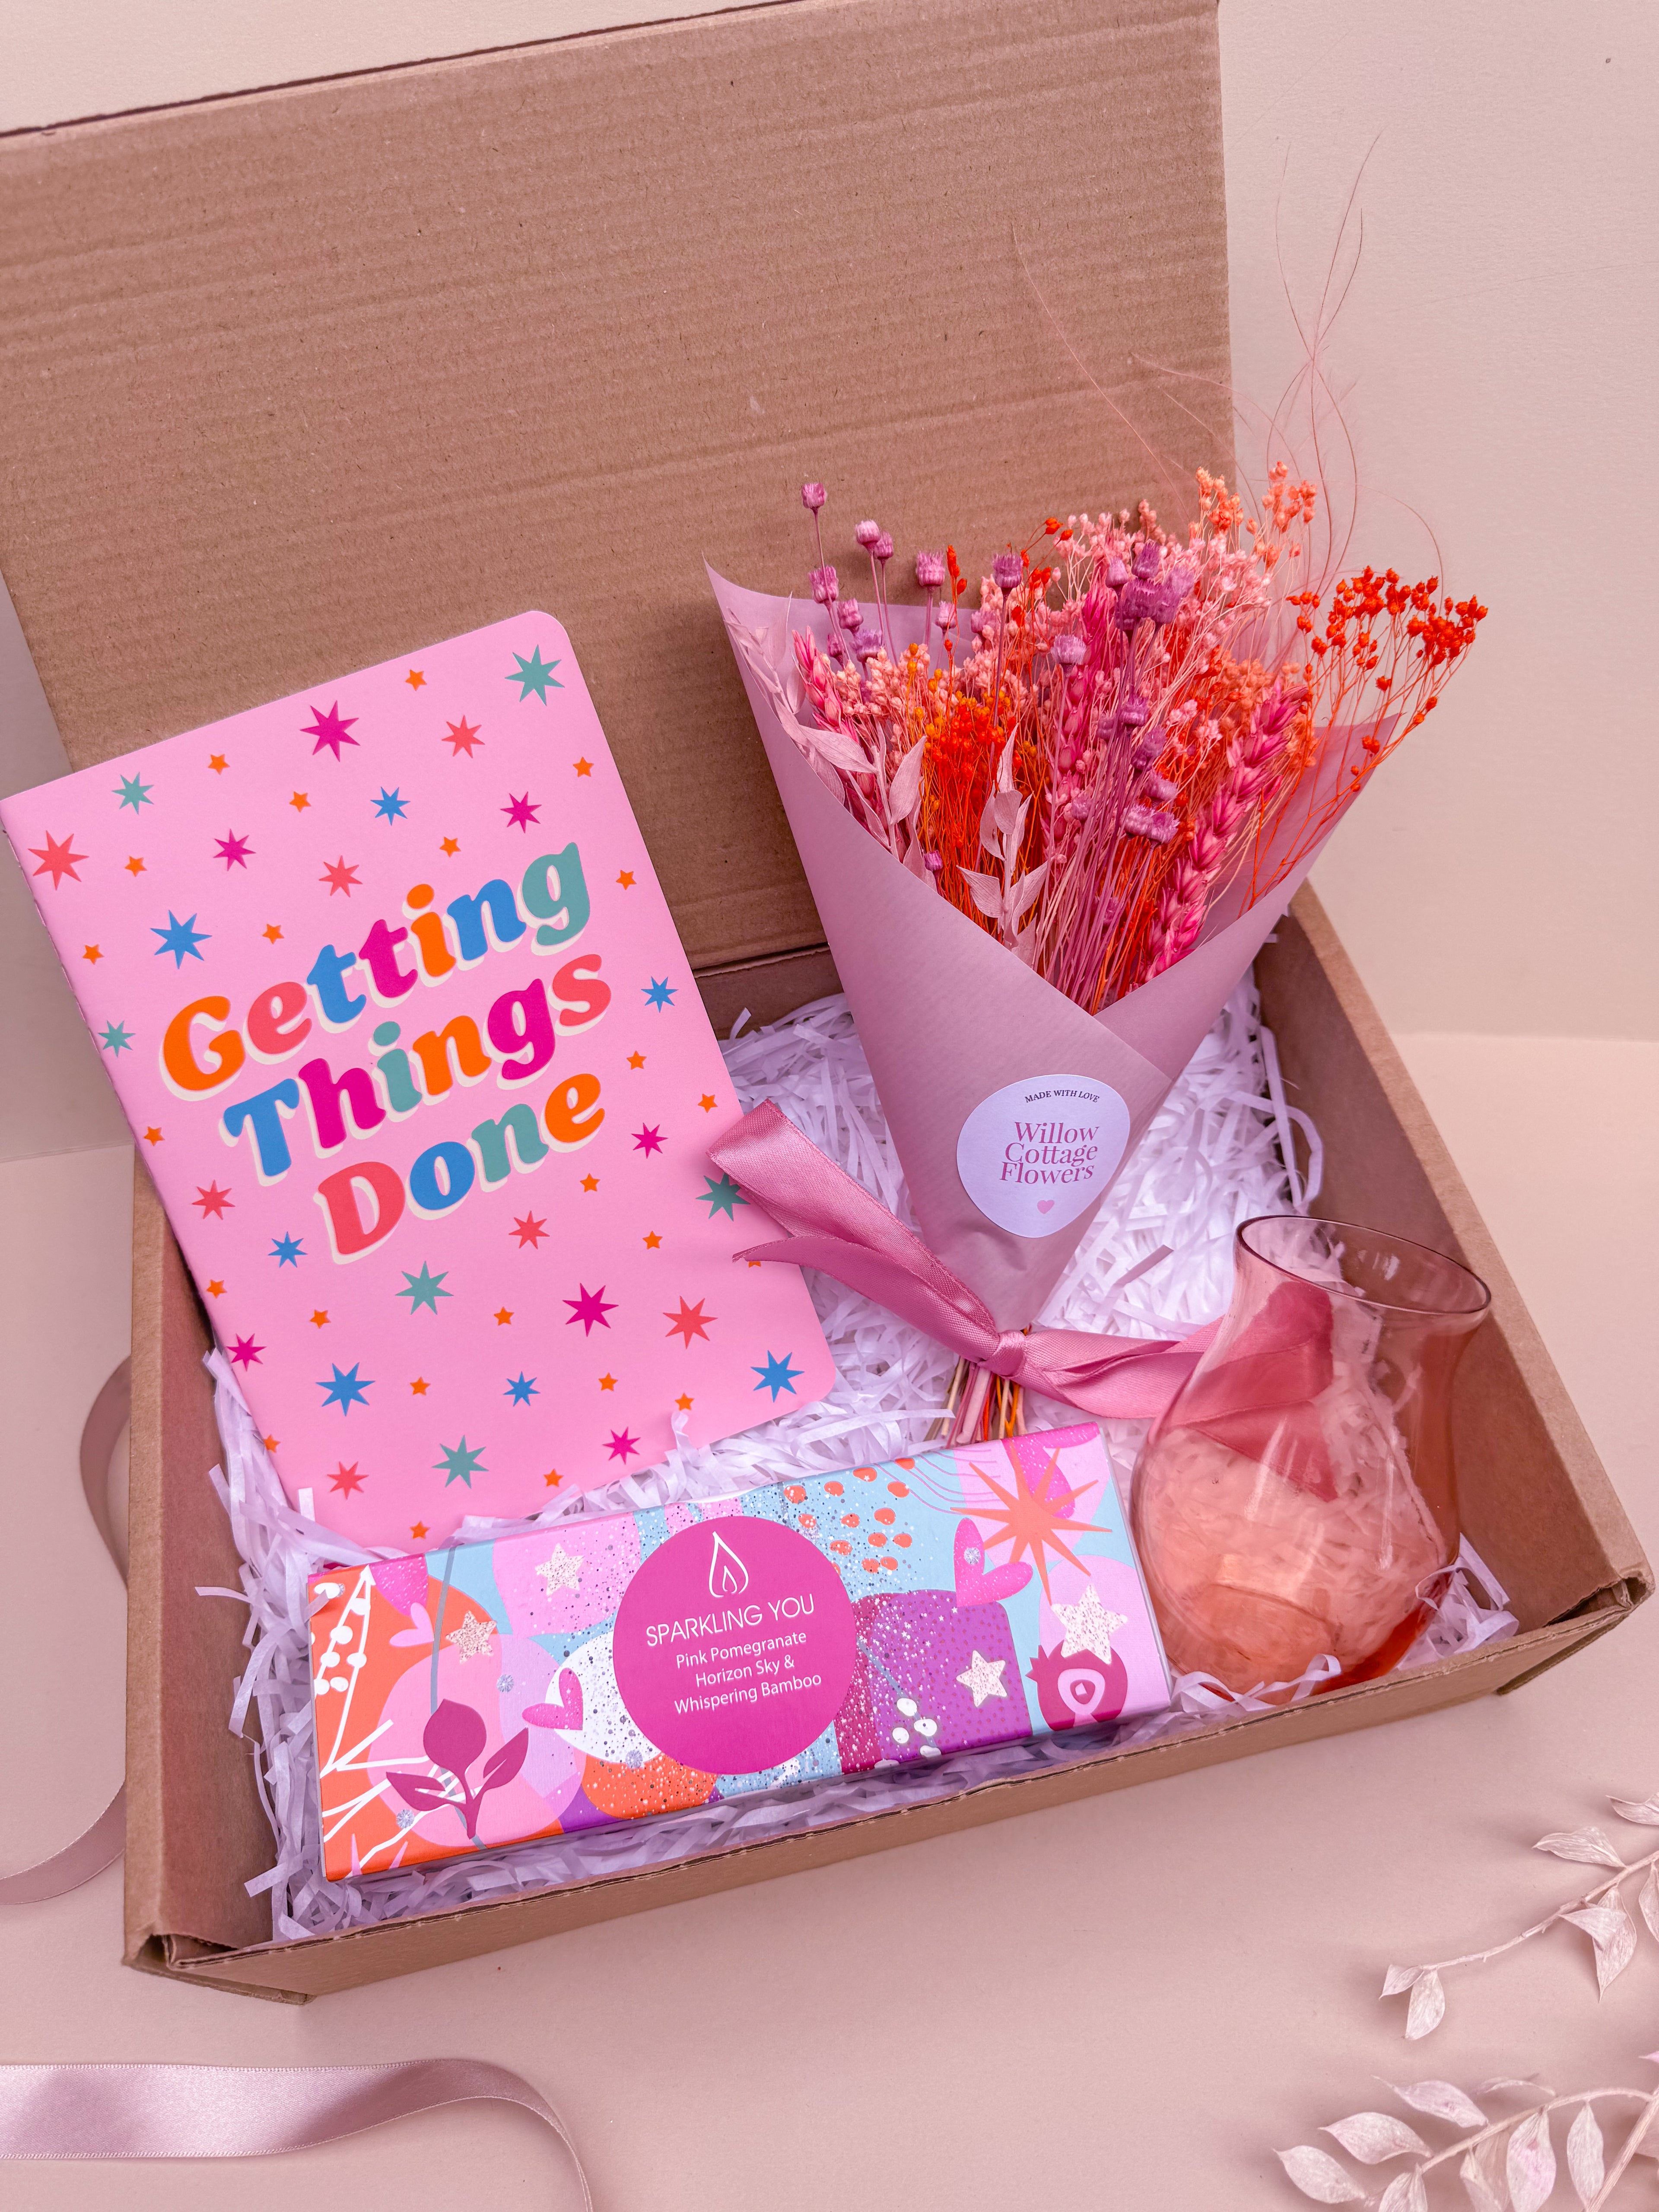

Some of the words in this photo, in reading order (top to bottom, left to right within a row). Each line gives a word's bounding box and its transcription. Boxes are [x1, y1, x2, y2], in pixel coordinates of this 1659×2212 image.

[159, 842, 590, 1100] Getting
[219, 954, 611, 1186] Things
[1025, 1091, 1052, 1103] MADE
[1078, 1091, 1100, 1103] LOVE
[1014, 1122, 1100, 1144] Willow
[313, 1073, 604, 1264] Done
[999, 1161, 1094, 1184] Flowers
[1005, 1143, 1097, 1167] Cottage
[646, 1605, 763, 1646] SPARKLING
[768, 1593, 814, 1621] YOU
[676, 1649, 708, 1669] Pink
[711, 1631, 807, 1660] Pomegranate
[696, 1666, 752, 1687] Horizon
[756, 1658, 779, 1675] Sky
[784, 1655, 795, 1669] &
[674, 1686, 757, 1714] Whispering
[761, 1675, 822, 1696] Bamboo
